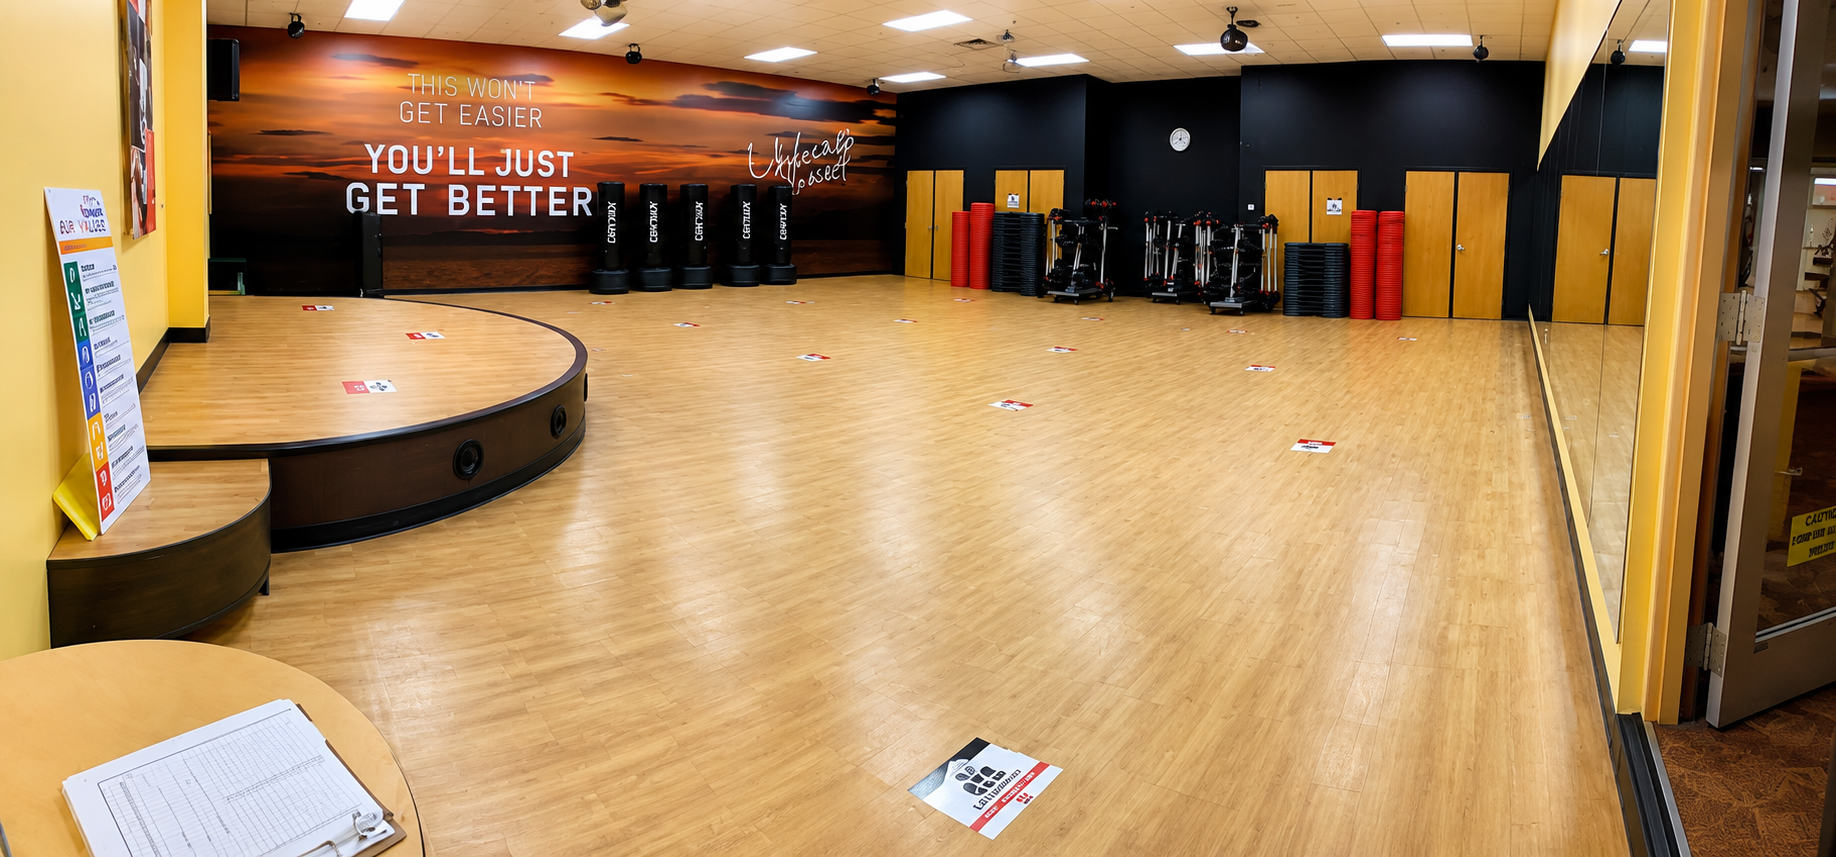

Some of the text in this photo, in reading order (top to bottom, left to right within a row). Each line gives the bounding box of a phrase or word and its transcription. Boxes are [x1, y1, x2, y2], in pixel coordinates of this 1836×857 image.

[407, 73, 536, 101] THIS WON'T
[399, 101, 543, 128] GET EASIER
[364, 143, 574, 178] YOU'LL JUST
[346, 182, 593, 217] GET BETTER
